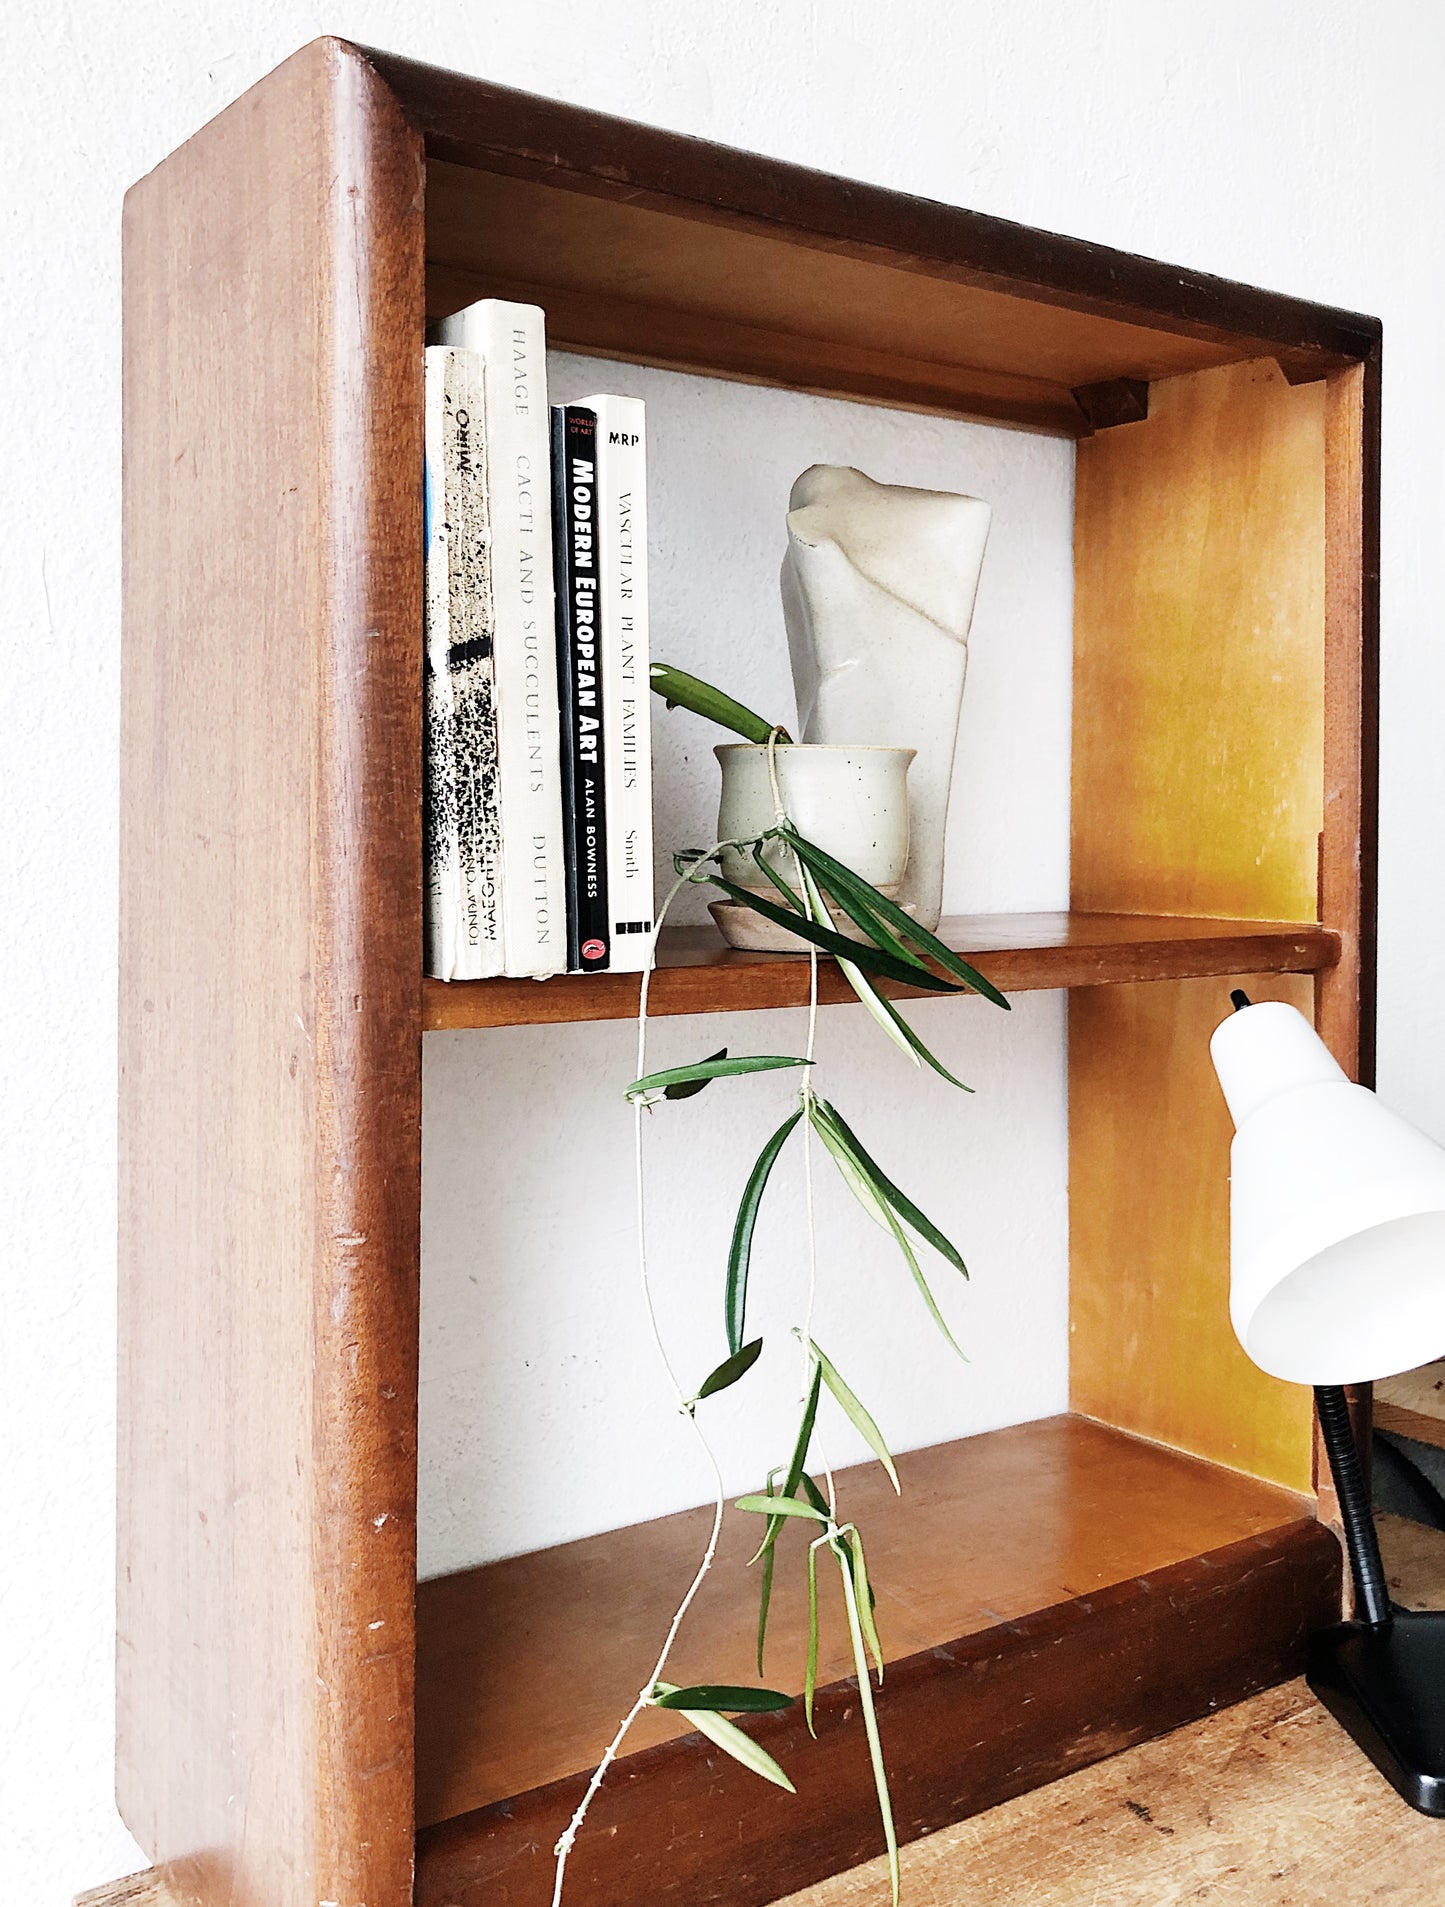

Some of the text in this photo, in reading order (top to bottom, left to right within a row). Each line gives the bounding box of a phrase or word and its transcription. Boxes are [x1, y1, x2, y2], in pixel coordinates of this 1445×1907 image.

[569, 417, 594, 427] WORLD
[580, 428, 593, 436] ART
[608, 431, 639, 446] MRP
[512, 329, 550, 945] HAAGE CACTI AND SUCCULENTS DUTTON
[572, 458, 600, 898] MODERN EUROPEAN ART ALAN BOWNESS
[618, 492, 640, 879] VASCULAR PLANT FAMILIES Smith
